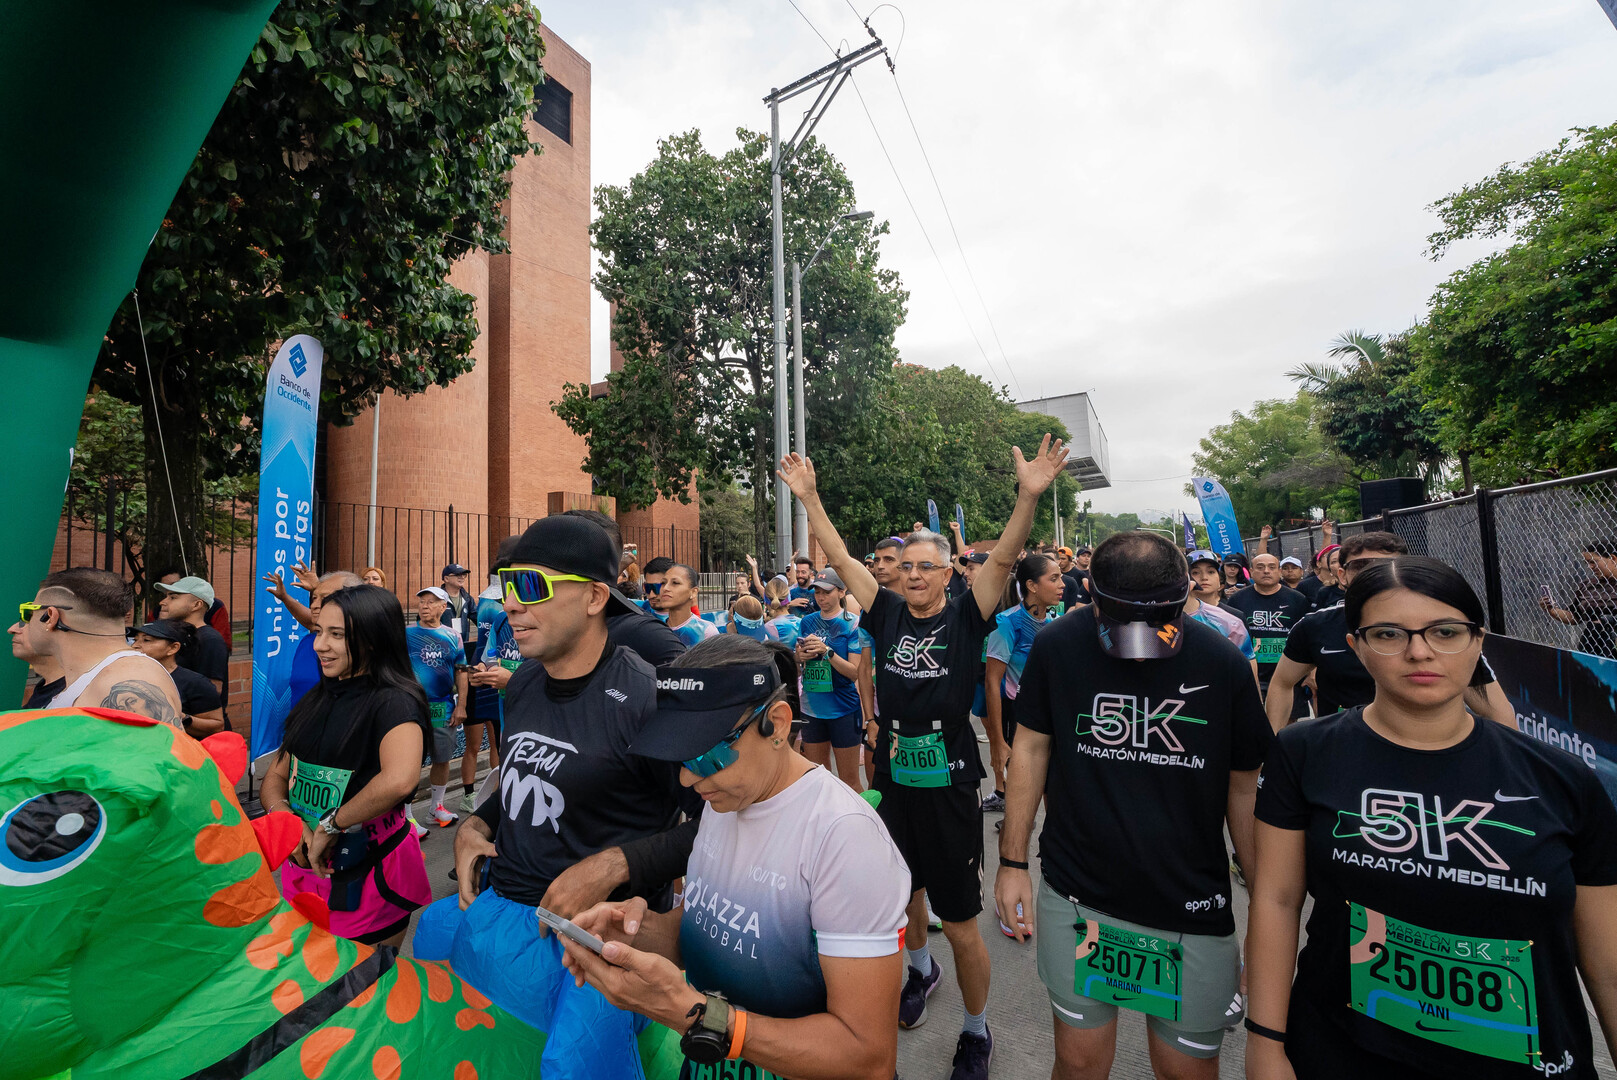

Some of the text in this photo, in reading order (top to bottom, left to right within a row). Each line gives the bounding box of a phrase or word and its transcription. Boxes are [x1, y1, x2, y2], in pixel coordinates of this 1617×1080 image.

[277, 386, 312, 413] Occidente
[280, 374, 311, 400] Banco de
[275, 487, 291, 540] por
[1214, 520, 1232, 556] fuerte!
[1253, 610, 1284, 628] 5K
[894, 635, 940, 670] 5K
[1257, 644, 1283, 654] 26786
[1091, 692, 1186, 752] 5K
[1510, 703, 1597, 770] ccidente
[501, 731, 579, 783] TEAM
[894, 749, 937, 768] 28160
[1077, 743, 1205, 769] MARATÓN MEDELLÍN
[292, 776, 331, 810] 27000
[501, 767, 566, 834] MR
[1360, 788, 1511, 871] 5K
[1332, 848, 1547, 897] MARATÓN MEDELLÍN
[1185, 900, 1210, 913] epm
[695, 911, 758, 959] GLOBAL
[1385, 929, 1492, 961] MEDELLÍN 5K
[1386, 921, 1451, 946] MARATÓN
[1087, 941, 1161, 985] 25071
[1500, 955, 1520, 963] 2025
[1105, 976, 1142, 994] MARIANO
[1369, 941, 1503, 1013] 25068
[1418, 1000, 1450, 1021] YANI
